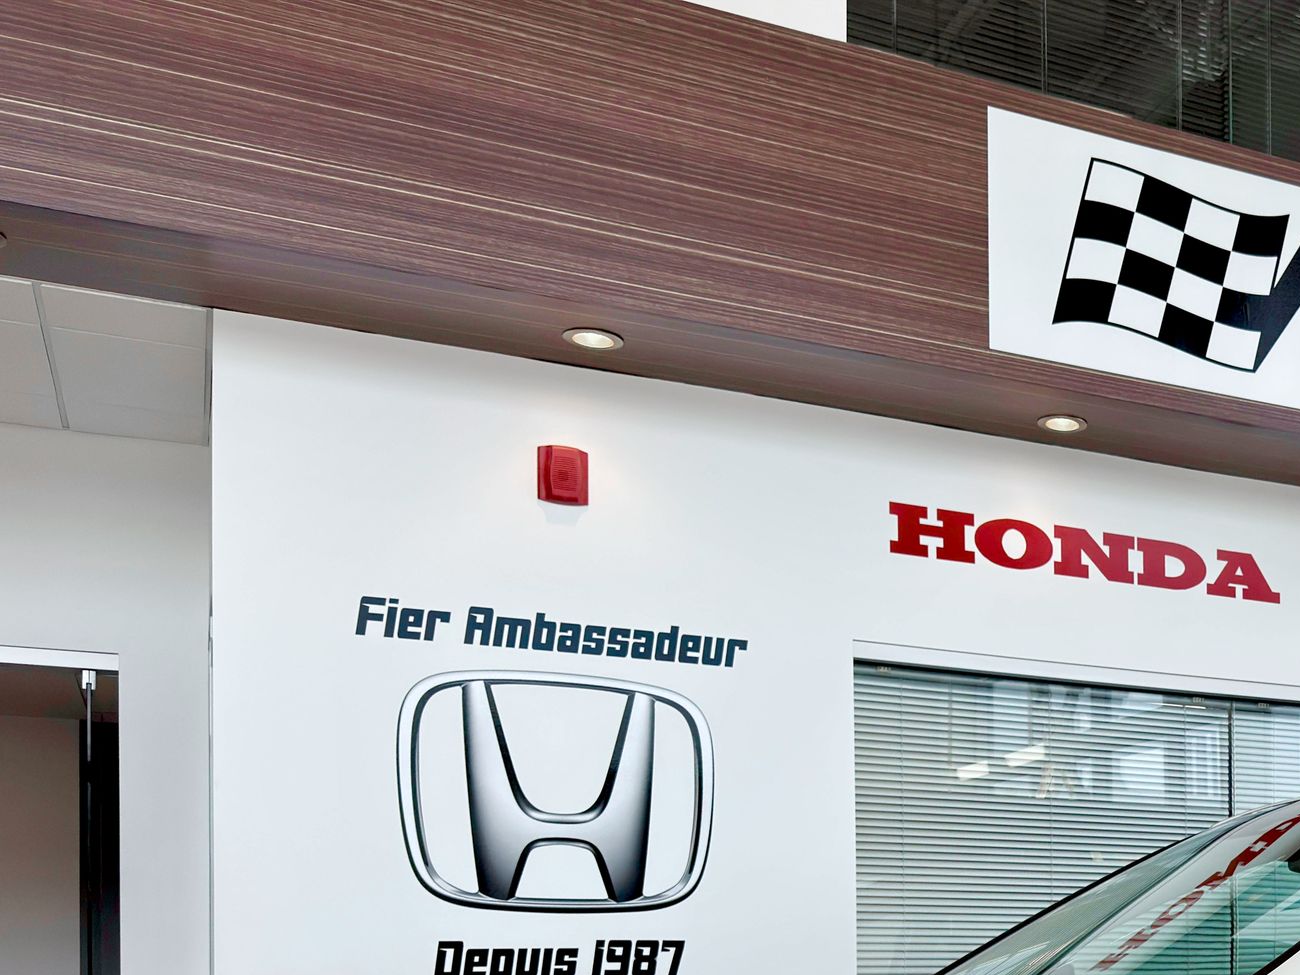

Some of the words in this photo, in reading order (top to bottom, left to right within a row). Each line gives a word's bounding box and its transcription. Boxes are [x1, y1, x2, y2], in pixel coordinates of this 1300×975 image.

[888, 501, 1281, 604] HONDA
[354, 595, 451, 642] Fier
[463, 605, 749, 668] Ambassadeur
